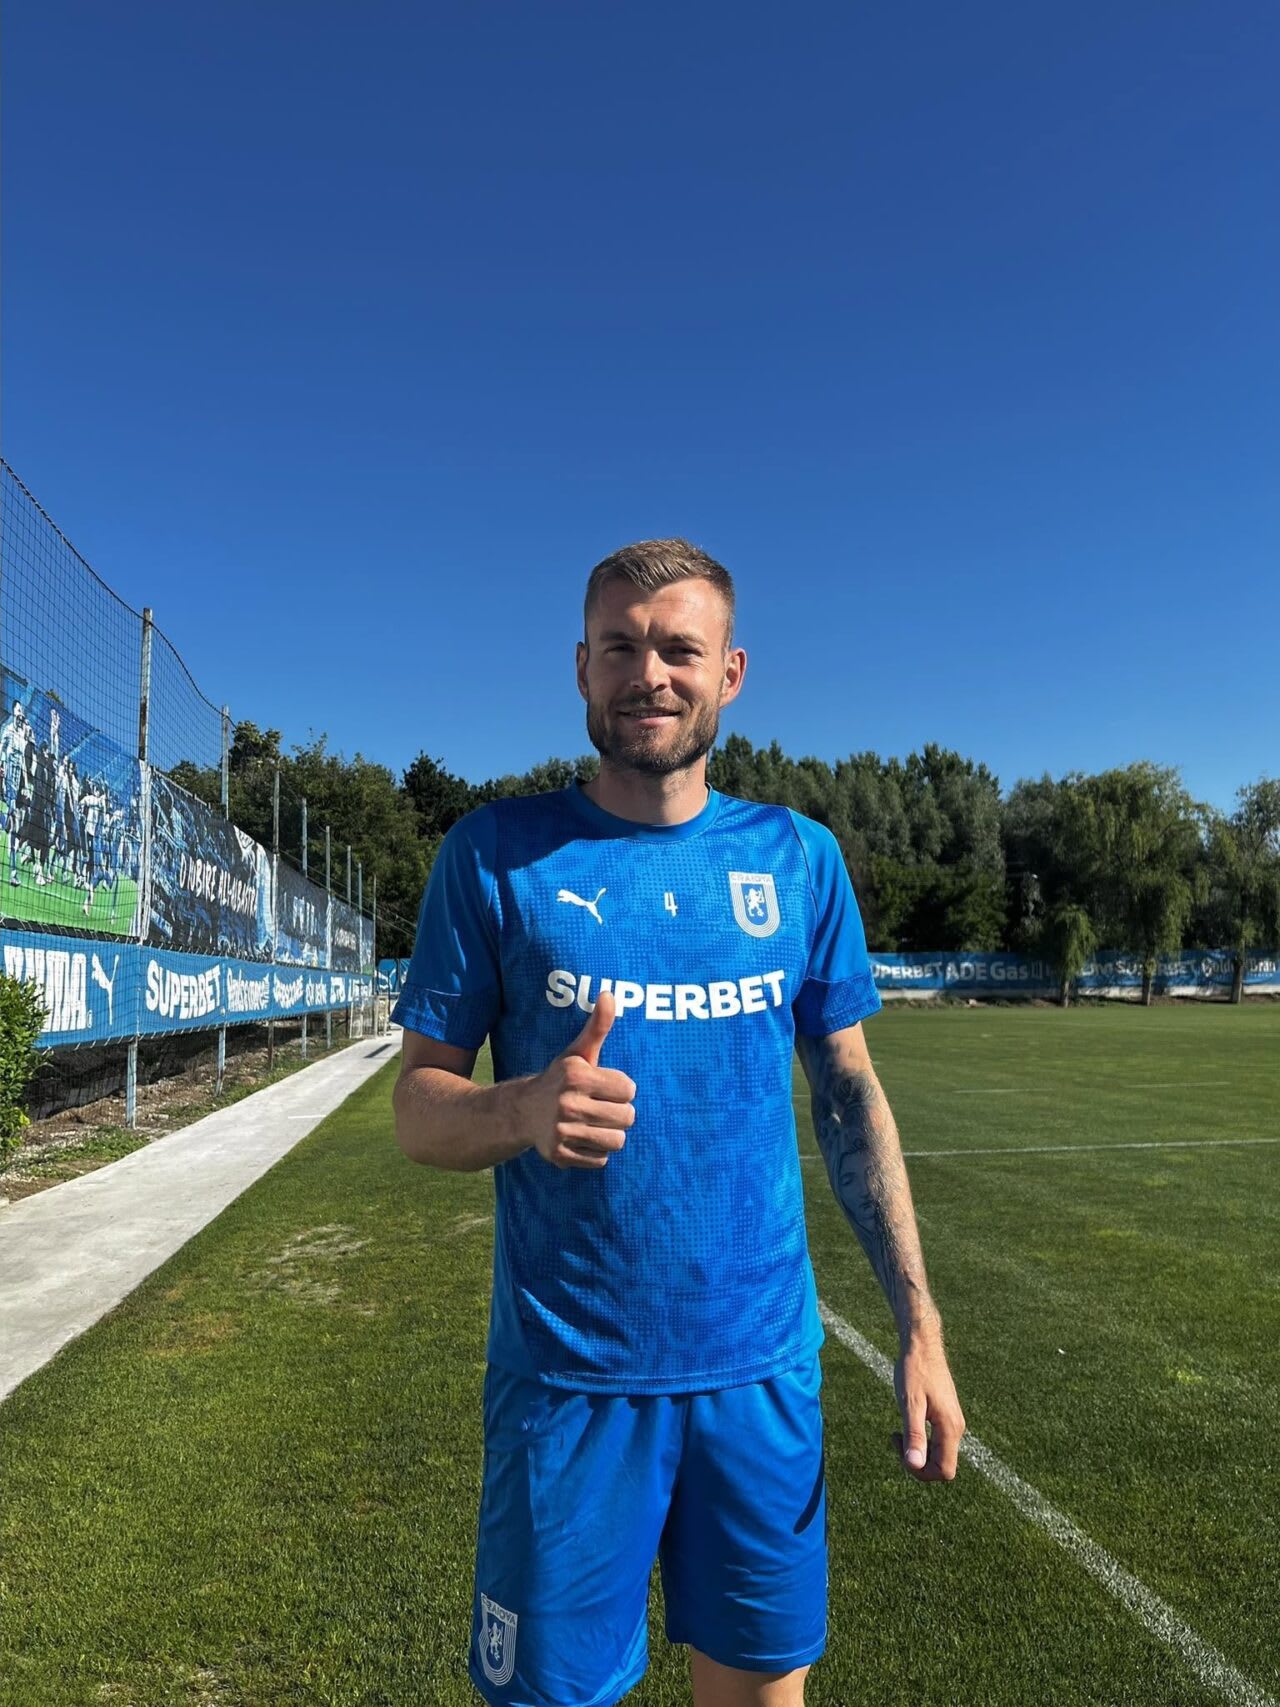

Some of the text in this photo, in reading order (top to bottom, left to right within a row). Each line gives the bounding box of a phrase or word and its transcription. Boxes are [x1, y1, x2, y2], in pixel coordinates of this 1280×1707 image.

[664, 892, 678, 917] 4
[871, 962, 942, 979] UPERBET
[990, 962, 1028, 980] Gas
[145, 959, 221, 1019] SUPERBET
[545, 969, 785, 1020] SUPERBET
